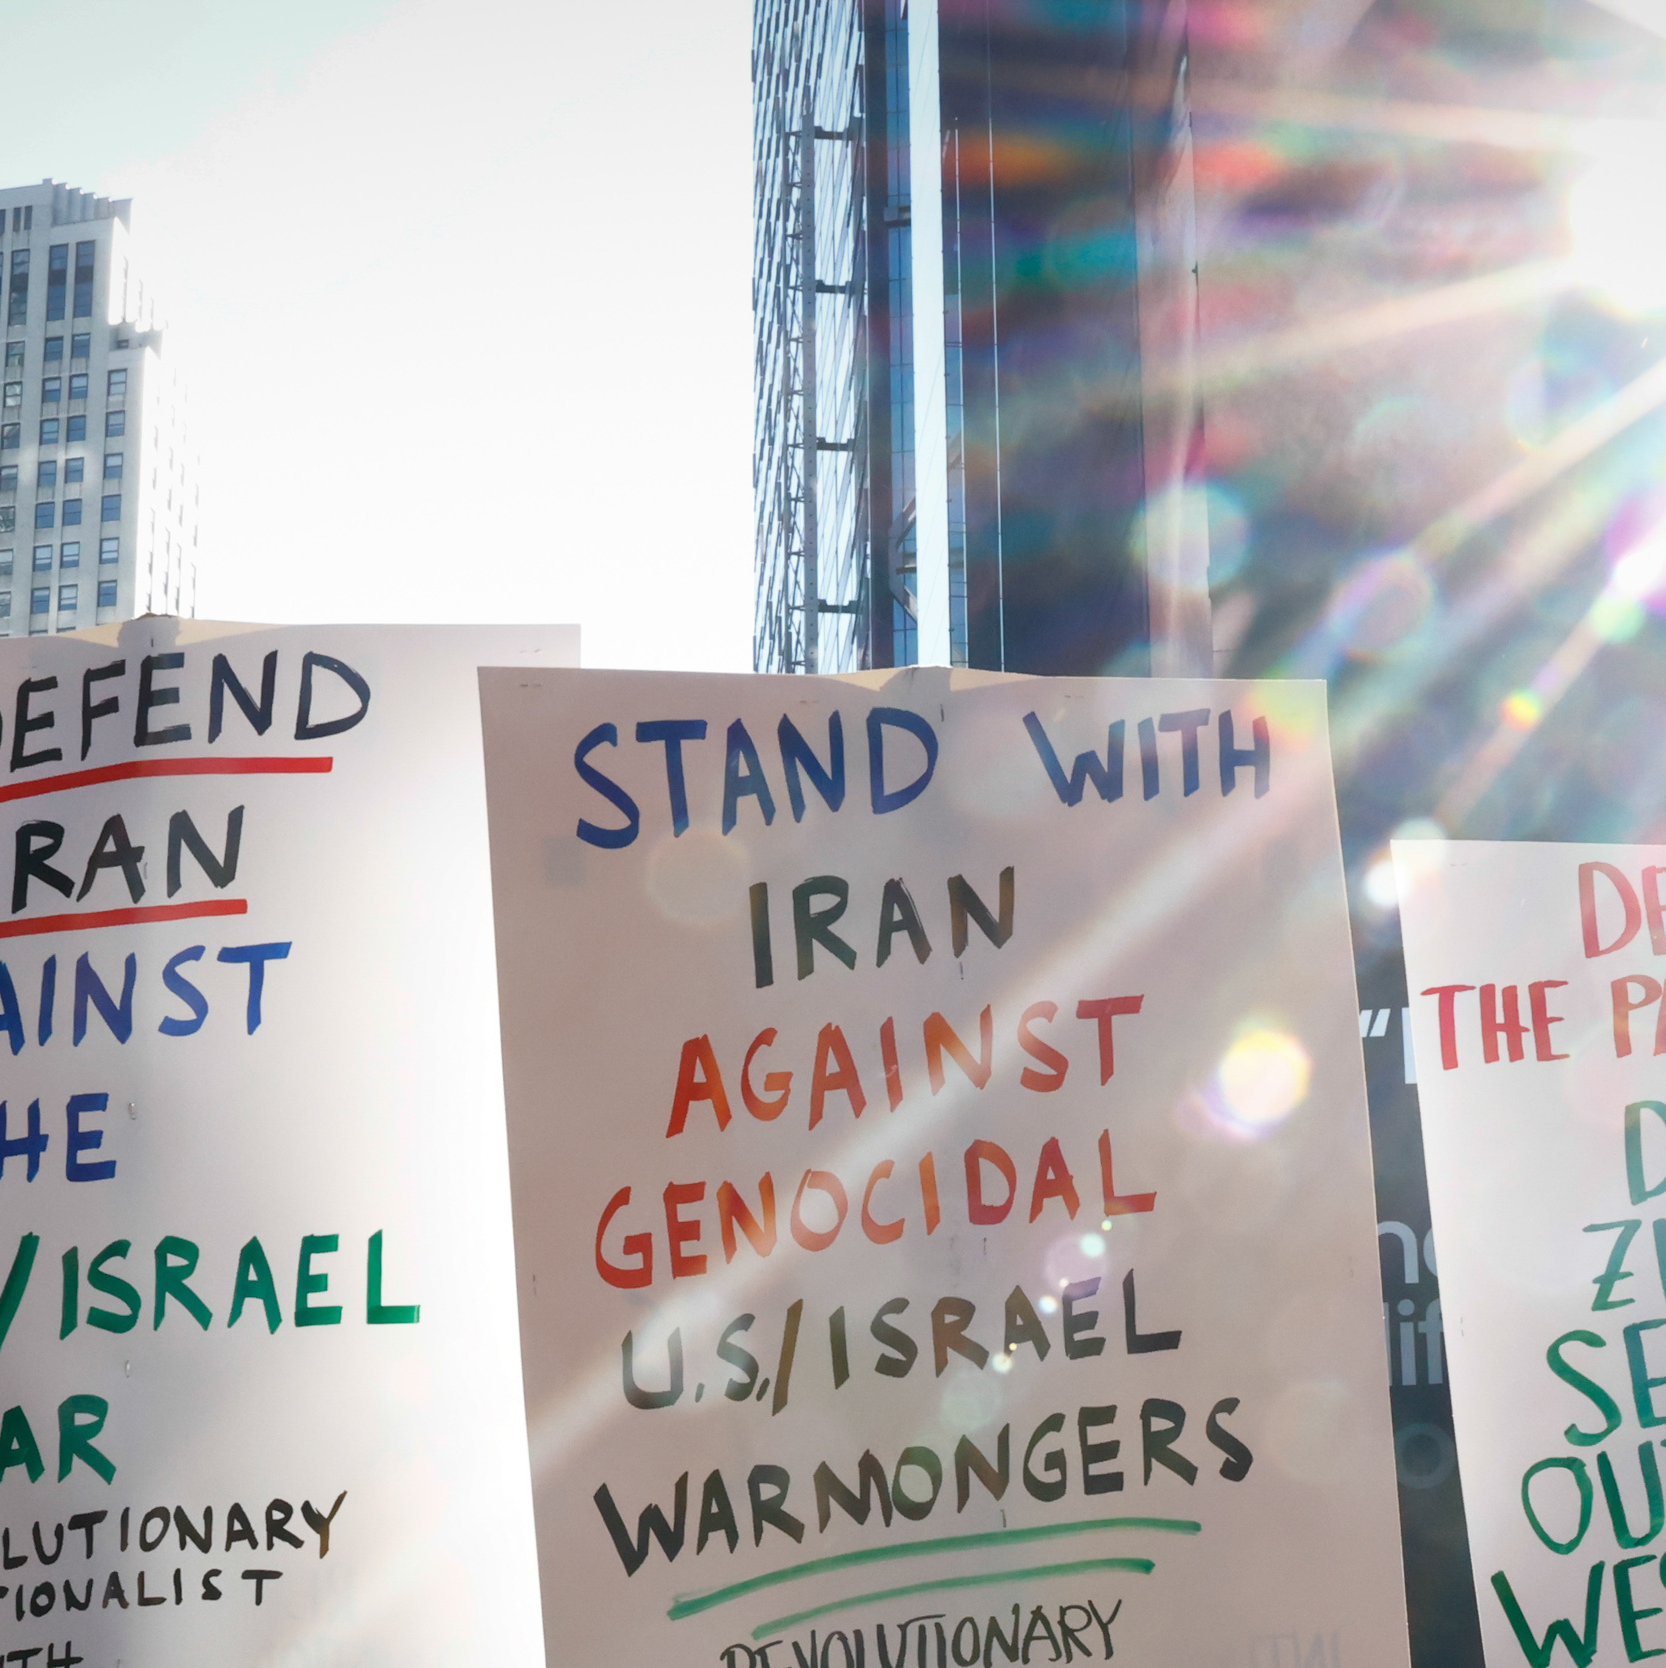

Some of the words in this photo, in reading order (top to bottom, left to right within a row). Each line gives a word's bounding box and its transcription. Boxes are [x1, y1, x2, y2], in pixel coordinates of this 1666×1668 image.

[573, 706, 939, 850] STAND
[1022, 707, 1271, 808] WITH
[748, 865, 1016, 989] IRAN
[664, 994, 1145, 1139] AGAINST
[1420, 979, 1569, 1070] THE
[594, 1128, 1158, 1291] GENOCIDAL
[620, 1267, 1182, 1416] U.S./ISRAEL
[592, 1397, 1254, 1578] WARMONGERS
